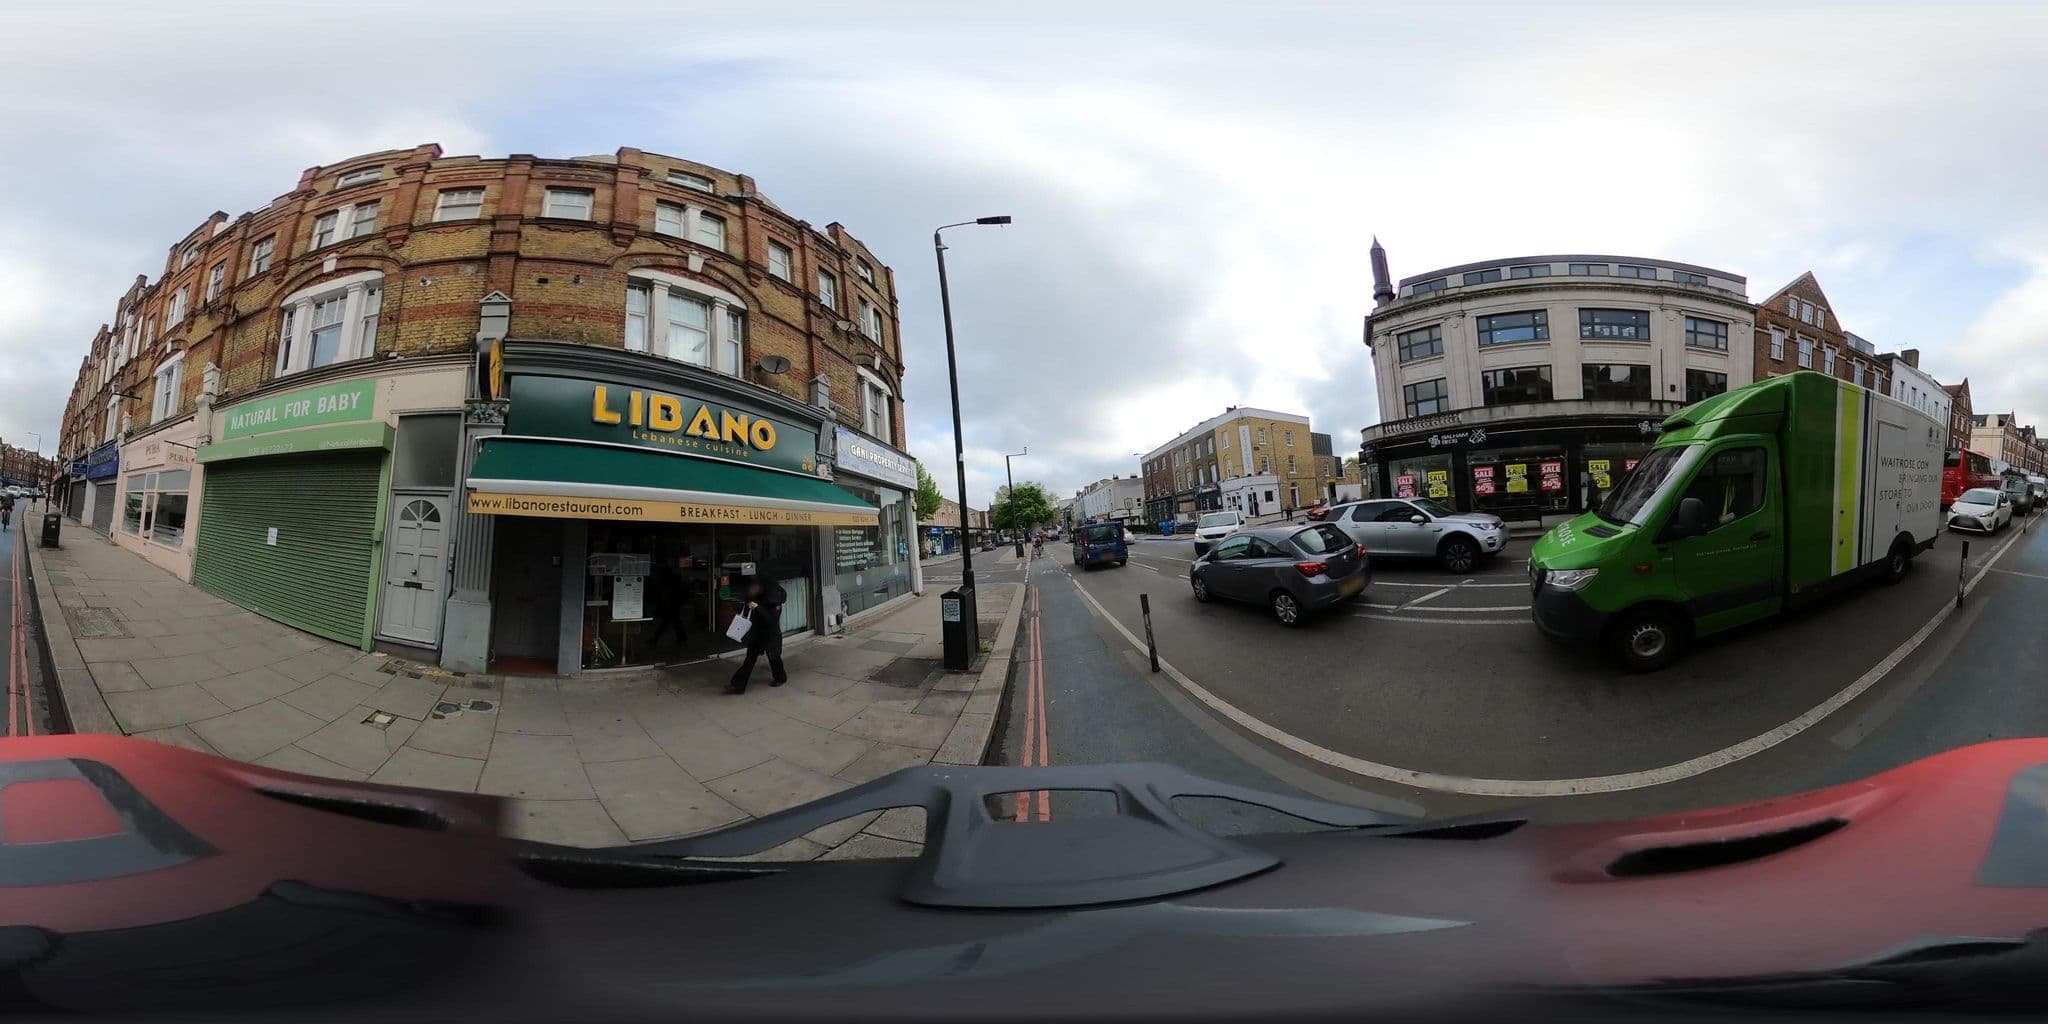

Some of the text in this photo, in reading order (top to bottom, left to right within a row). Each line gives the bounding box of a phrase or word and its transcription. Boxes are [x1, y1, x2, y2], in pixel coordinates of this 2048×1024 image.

[231, 391, 361, 430] NATURAL FOR BABY
[592, 386, 776, 451] LIBANO
[632, 429, 749, 458] Lebanese cuisine
[850, 444, 868, 459] GANI
[869, 451, 897, 471] PROPERTY
[1542, 465, 1561, 473] SALE
[1474, 470, 1494, 478] SALE
[470, 496, 643, 516] www.libanorestaurant.com
[680, 506, 812, 521] BREAKFAST LUNCH DINNER
